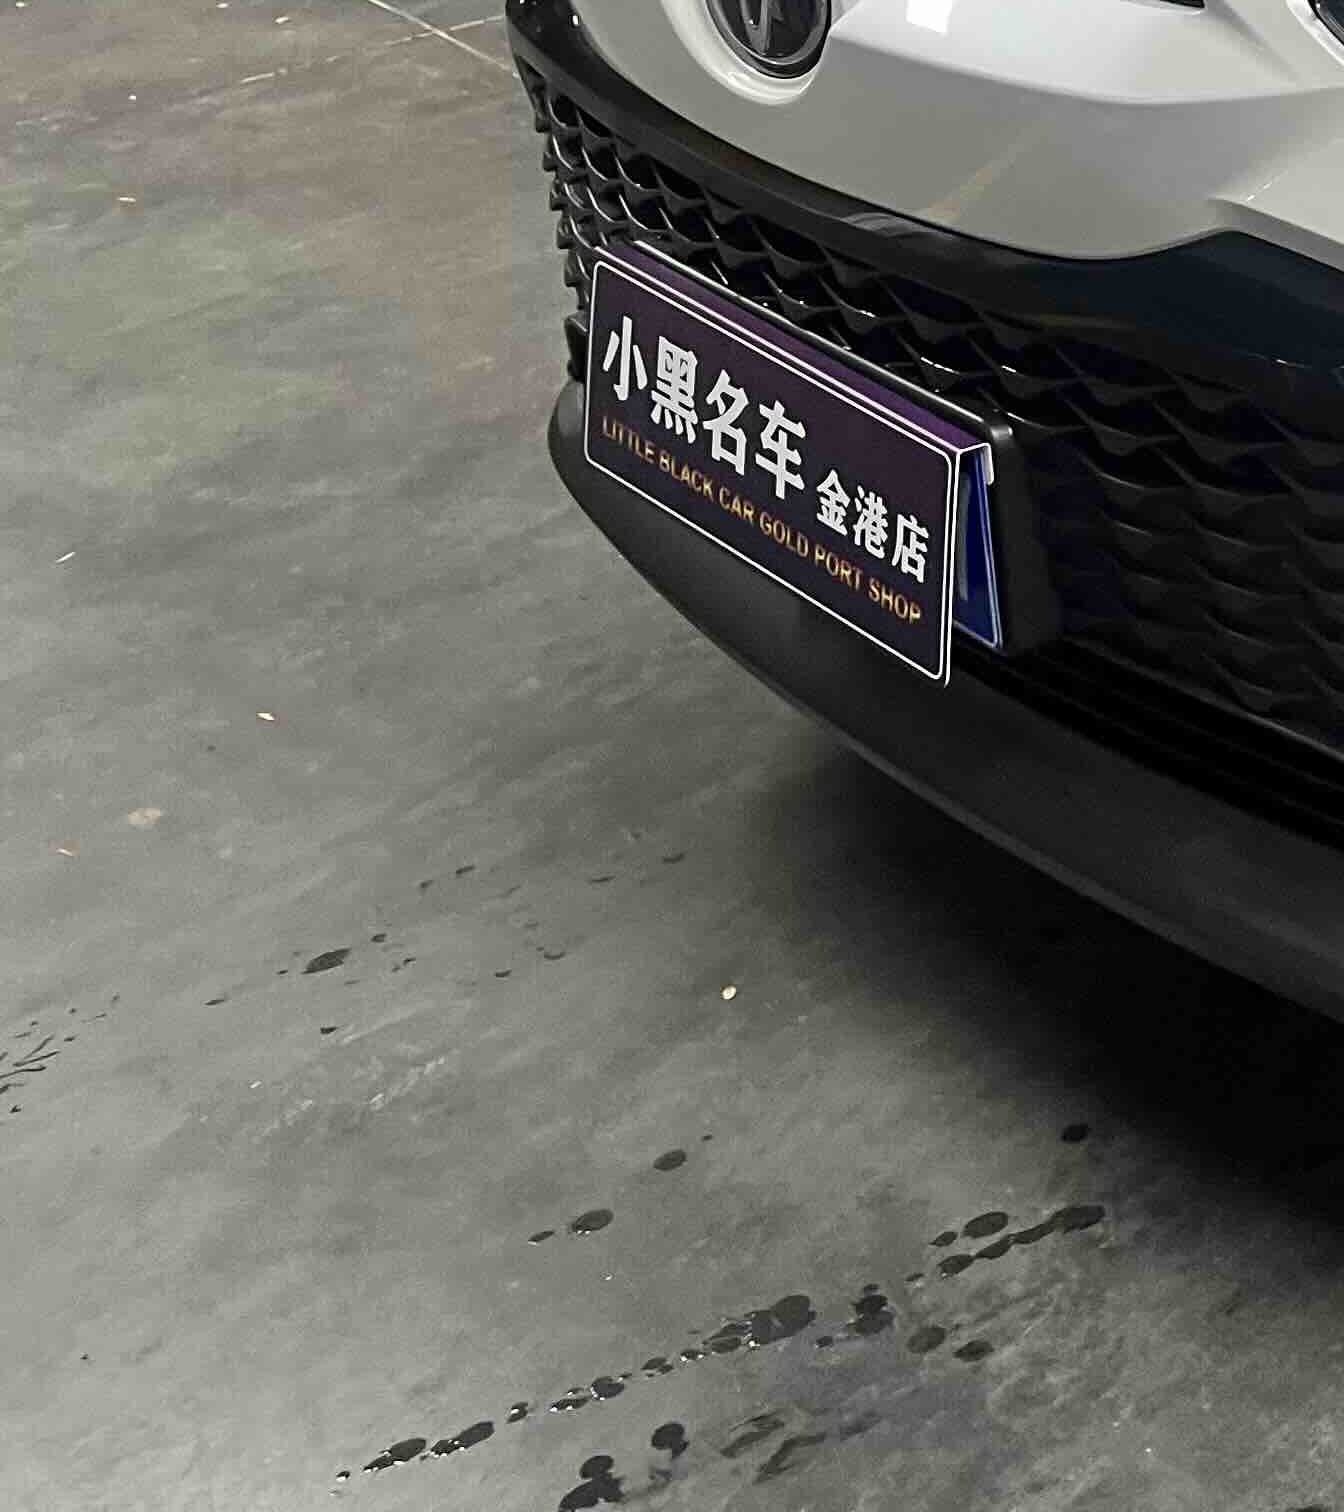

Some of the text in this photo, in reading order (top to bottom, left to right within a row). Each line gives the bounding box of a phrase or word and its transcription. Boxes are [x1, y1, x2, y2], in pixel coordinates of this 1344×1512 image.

[602, 416, 922, 624] LITTLE BLACK CAR GOLD PORT SHOP
[603, 316, 930, 584] 小黑名车 金港店
